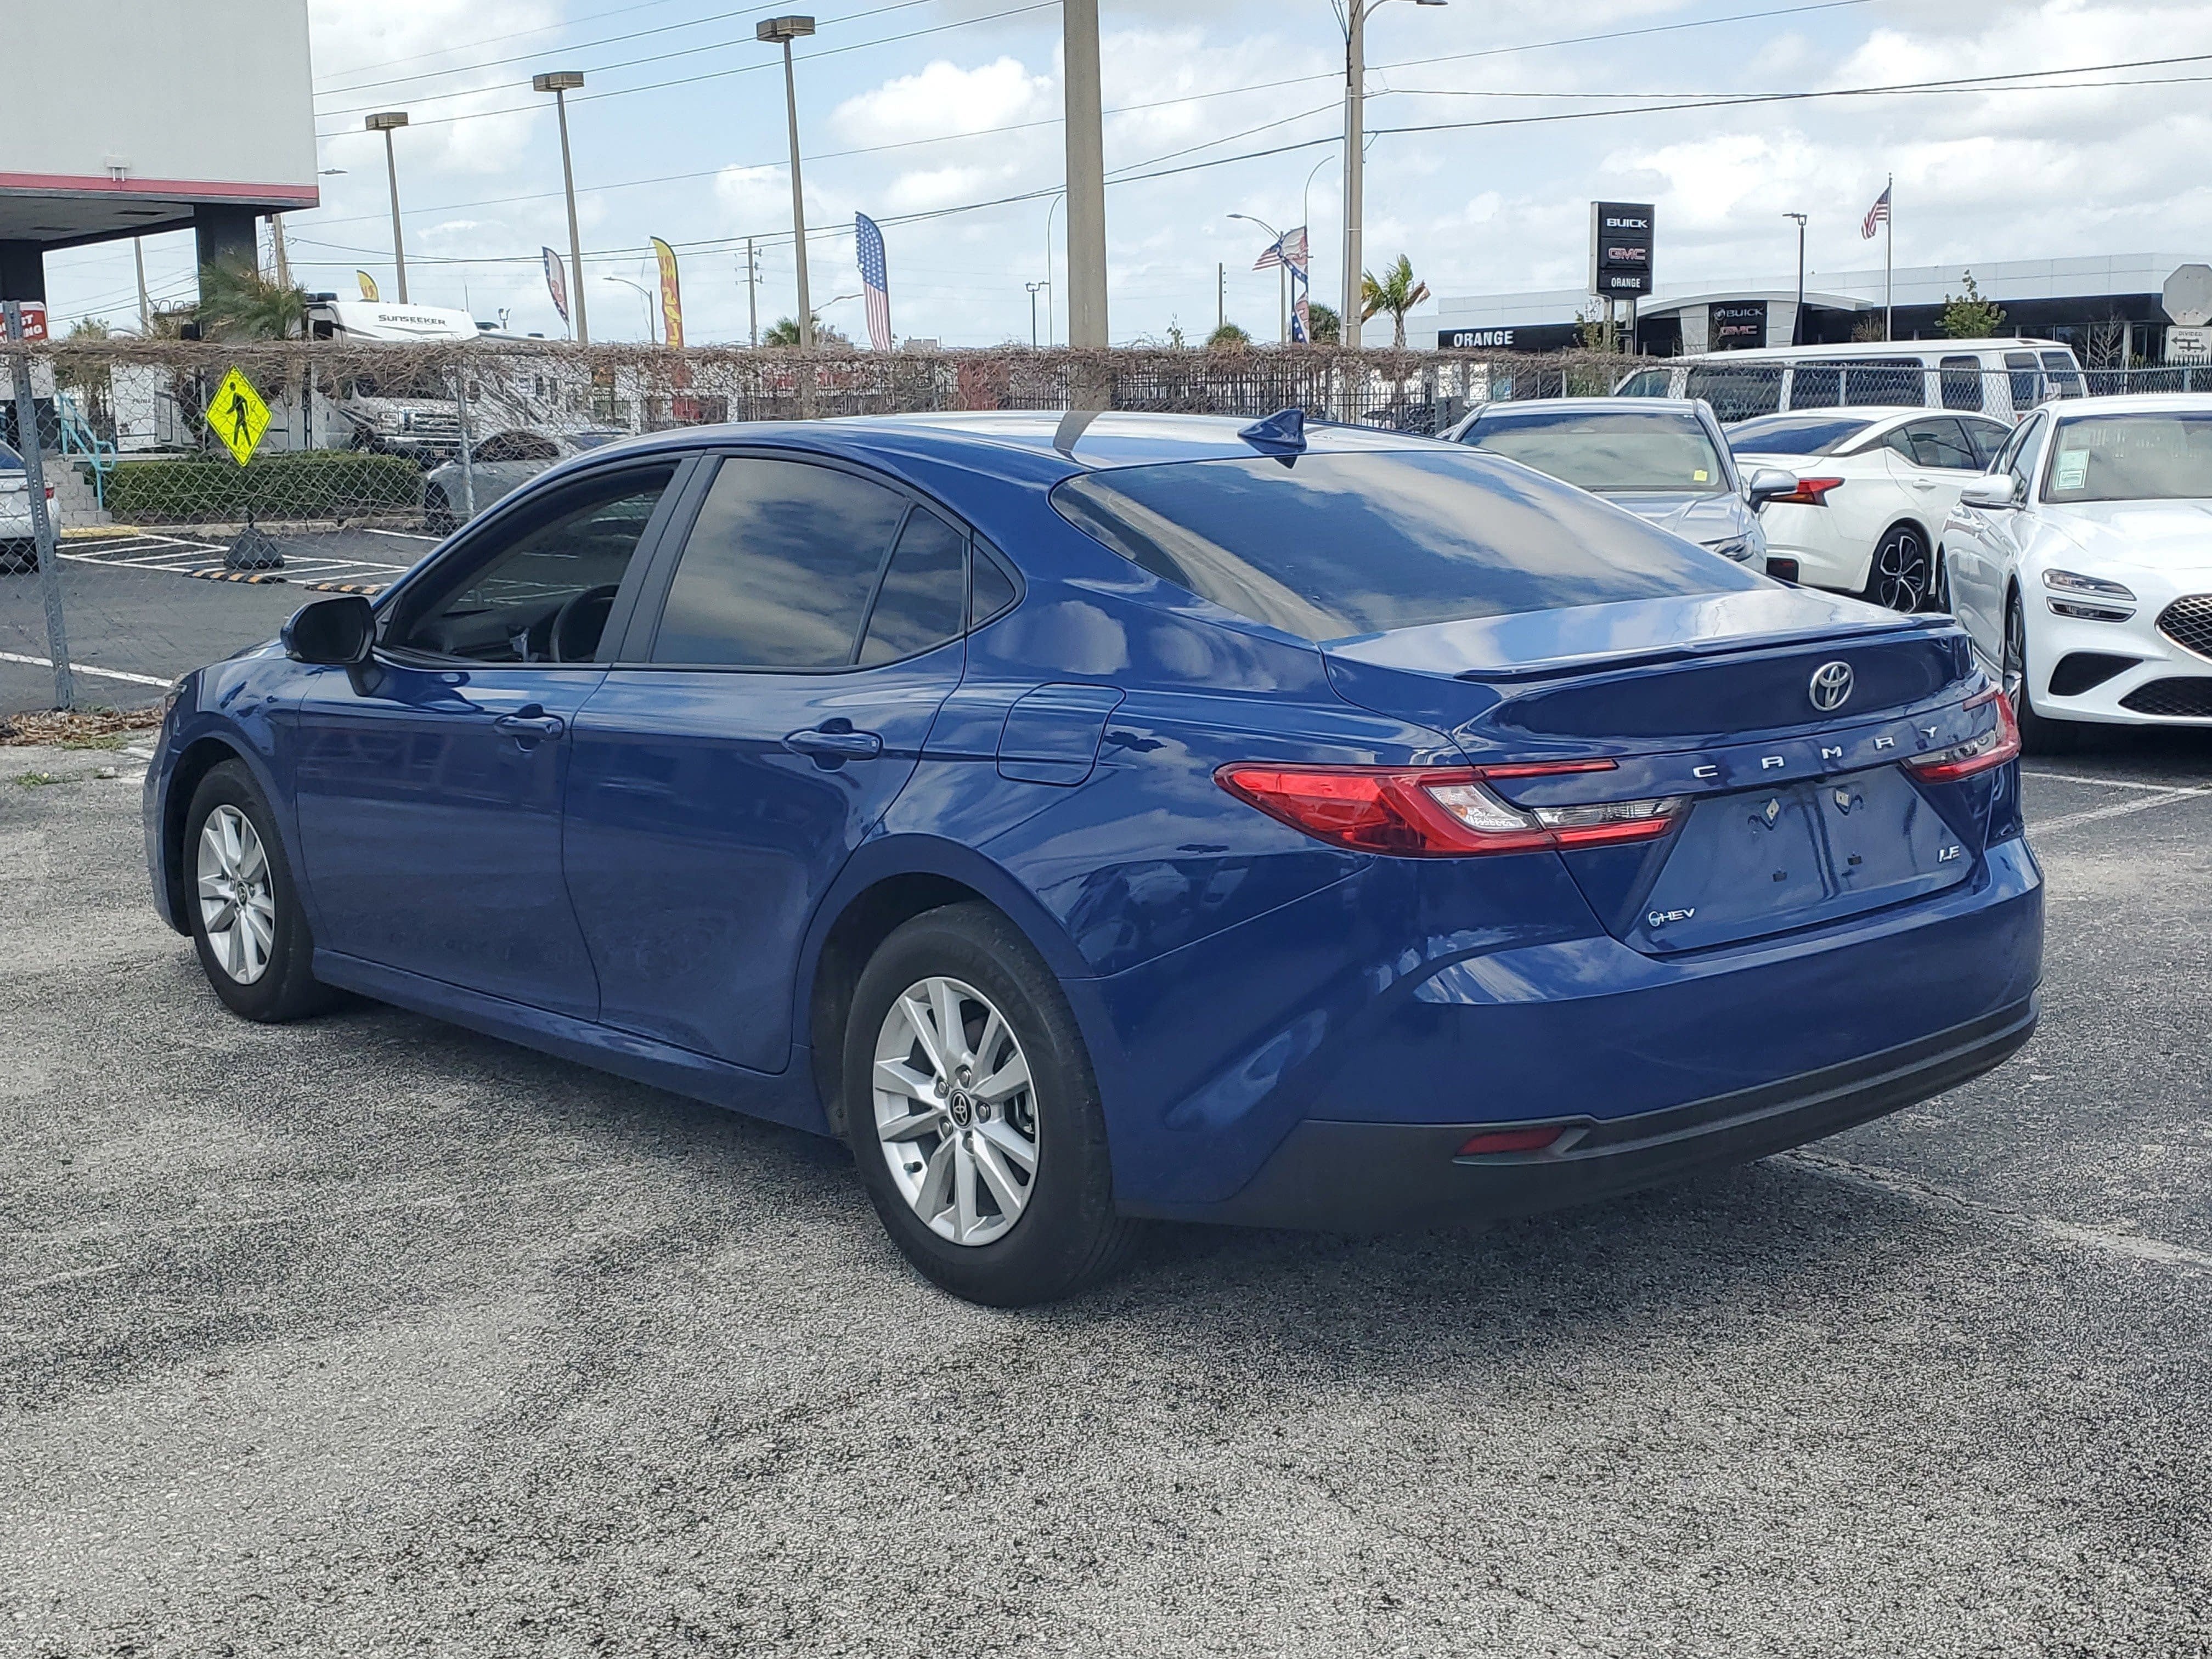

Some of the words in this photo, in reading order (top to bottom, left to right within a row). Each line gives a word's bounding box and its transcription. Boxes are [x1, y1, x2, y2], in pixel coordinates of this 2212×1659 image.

[1606, 218, 1648, 228] BUICK
[1608, 247, 1646, 260] GMC
[1611, 278, 1641, 288] ORANGE
[1726, 306, 1765, 317] BUICK
[378, 314, 447, 326] SUNSEEKER
[1720, 325, 1757, 336] GMC
[1453, 330, 1514, 347] ORANGE
[1692, 725, 1937, 778] CAMRY
[1938, 845, 1961, 862] LE
